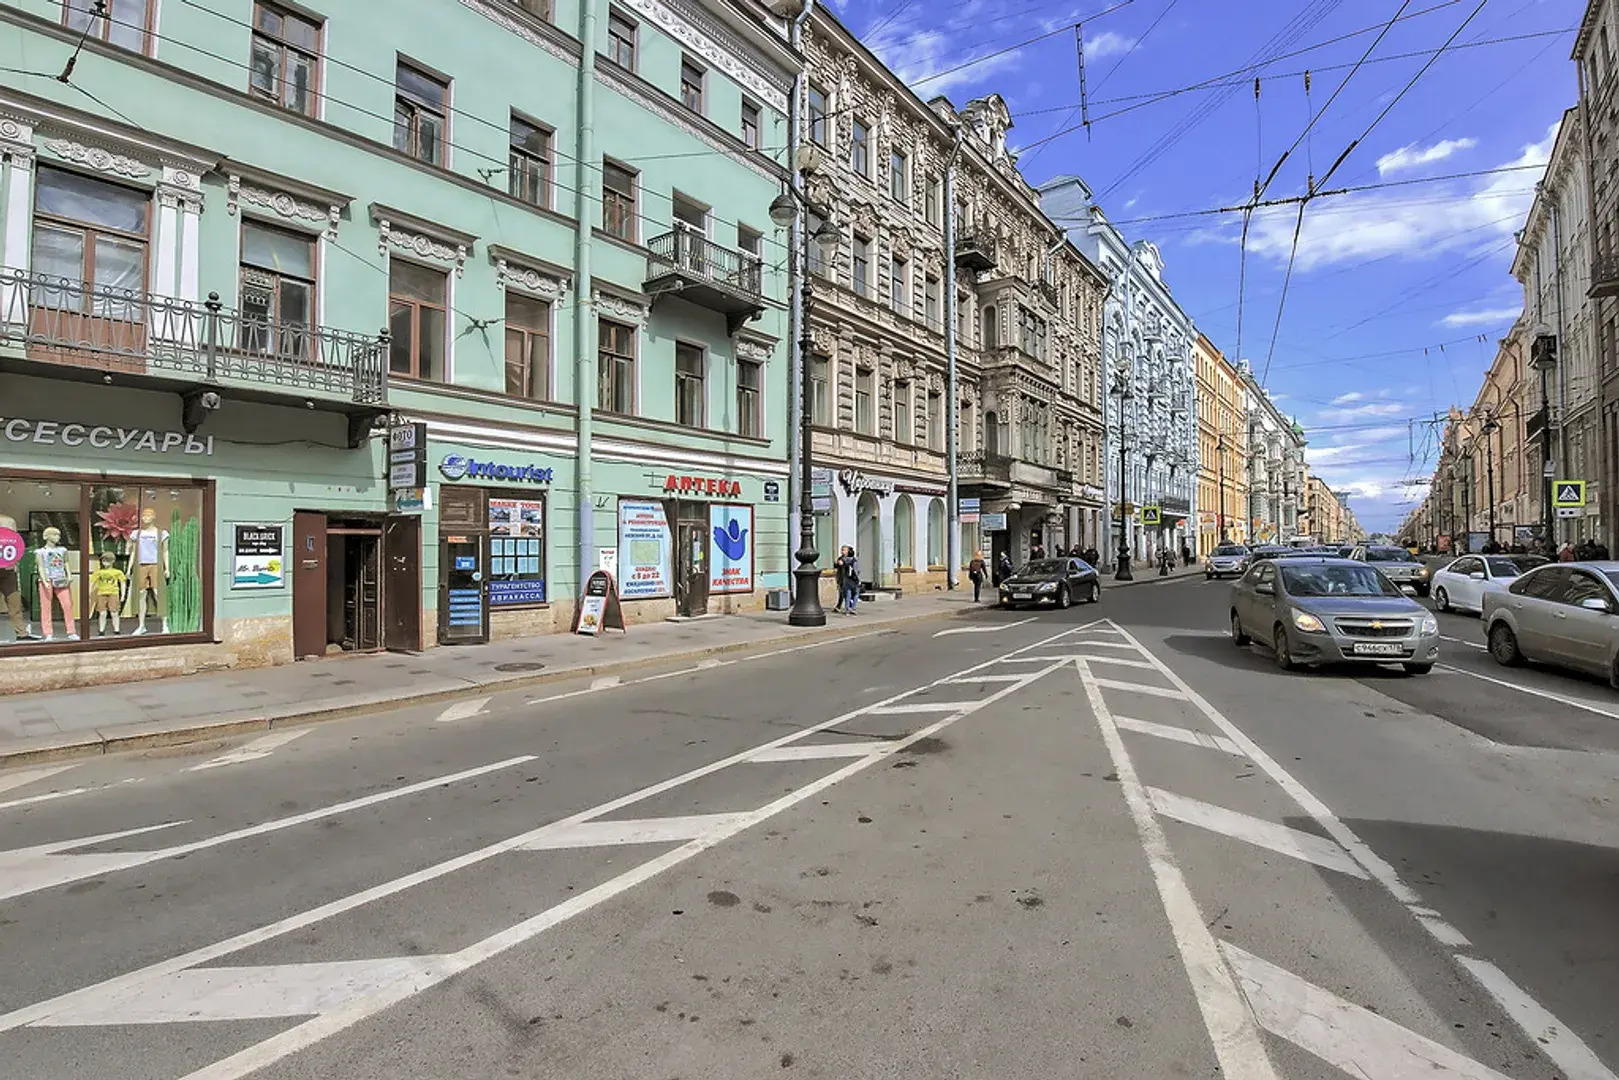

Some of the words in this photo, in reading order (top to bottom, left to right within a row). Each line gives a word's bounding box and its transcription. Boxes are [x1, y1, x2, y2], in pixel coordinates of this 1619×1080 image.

[0, 417, 214, 455] СЕССУАРЫ
[392, 429, 413, 441] ФОТО
[468, 459, 553, 483] Intourist
[665, 475, 742, 496] АПТЕКА
[491, 582, 541, 591] ТУРАГЕНТСТВО
[712, 577, 749, 586] КАЧЕСТВА
[491, 593, 541, 602] АВИАКАССА
